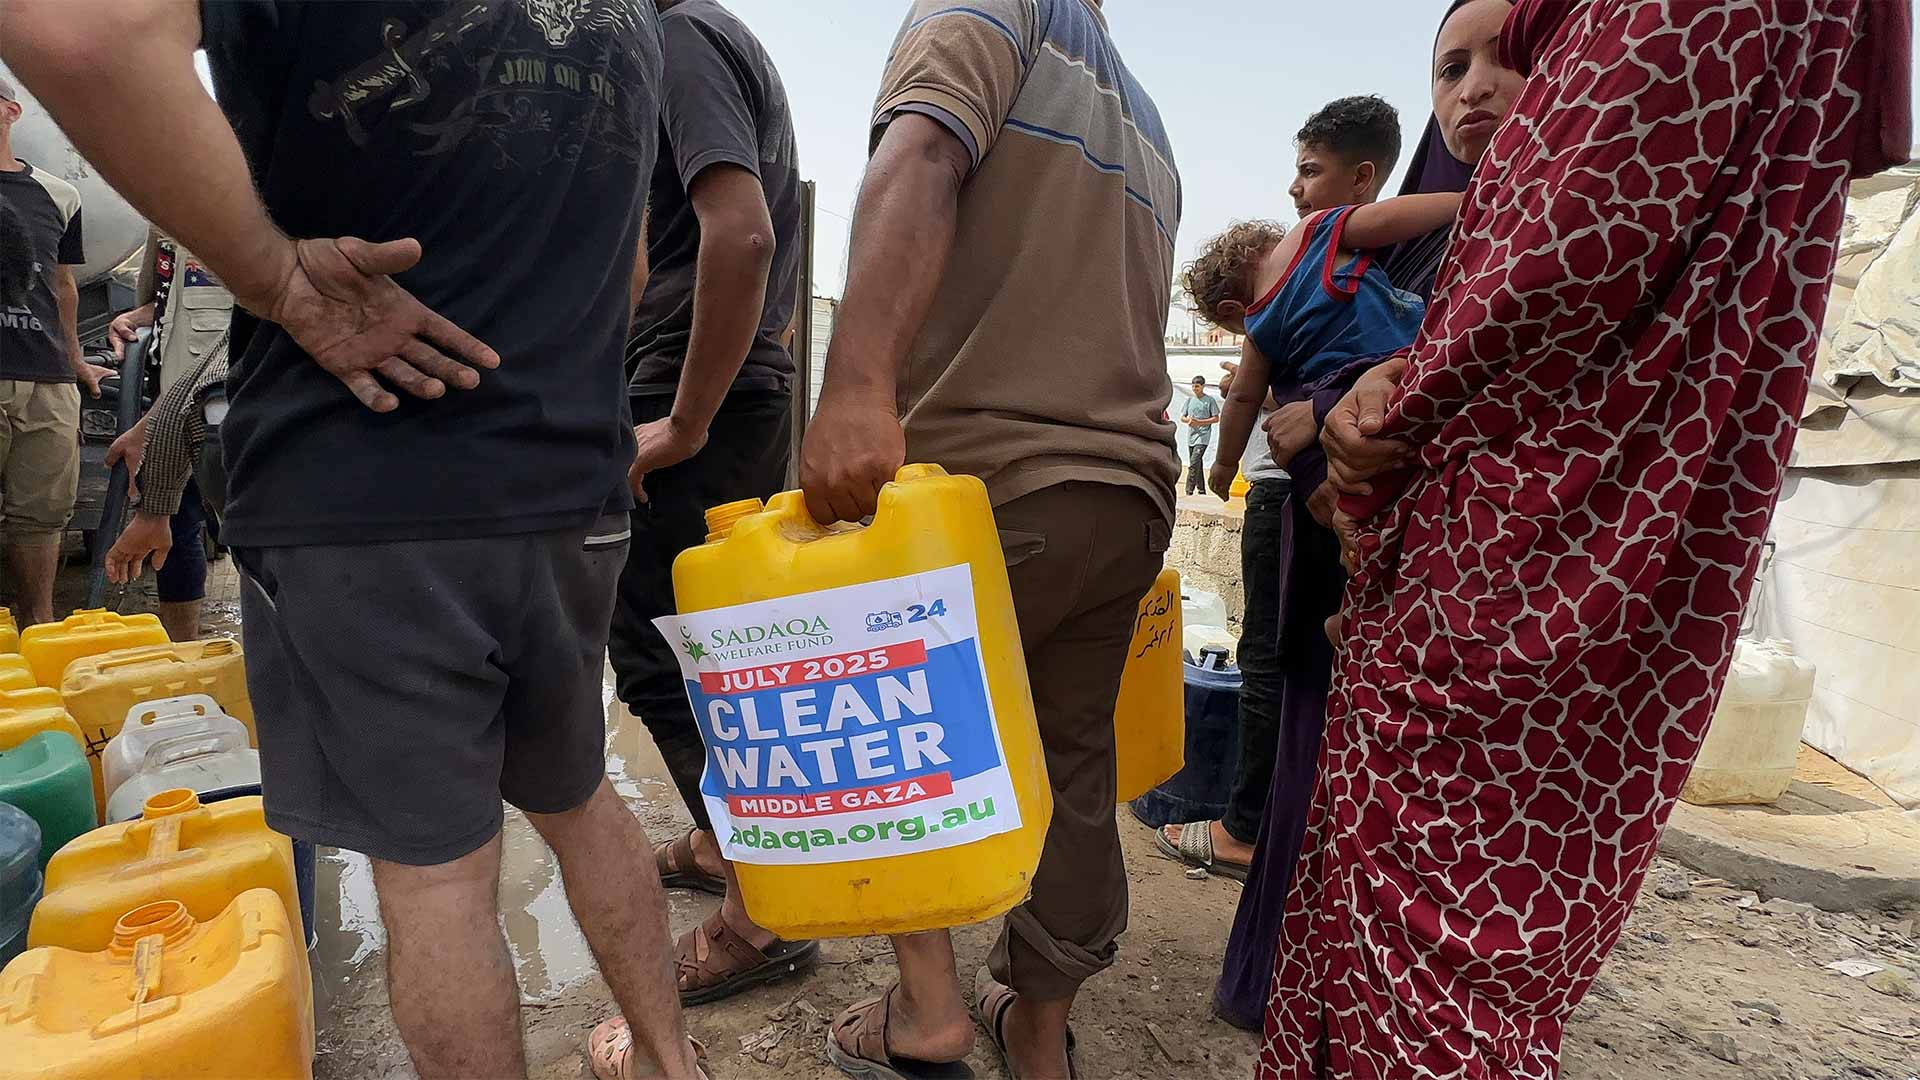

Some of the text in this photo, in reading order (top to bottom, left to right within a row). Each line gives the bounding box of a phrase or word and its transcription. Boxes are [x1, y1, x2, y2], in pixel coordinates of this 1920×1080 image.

[906, 598, 947, 624] 24
[710, 615, 831, 649] SADAQA
[714, 635, 834, 662] WELFARE FUND
[720, 649, 890, 693] JULY 2025
[708, 669, 934, 742] CLEAN
[713, 721, 952, 789] WATER
[740, 781, 927, 815] MIDDLE GAZA
[729, 795, 997, 853] adaqa.org.au
